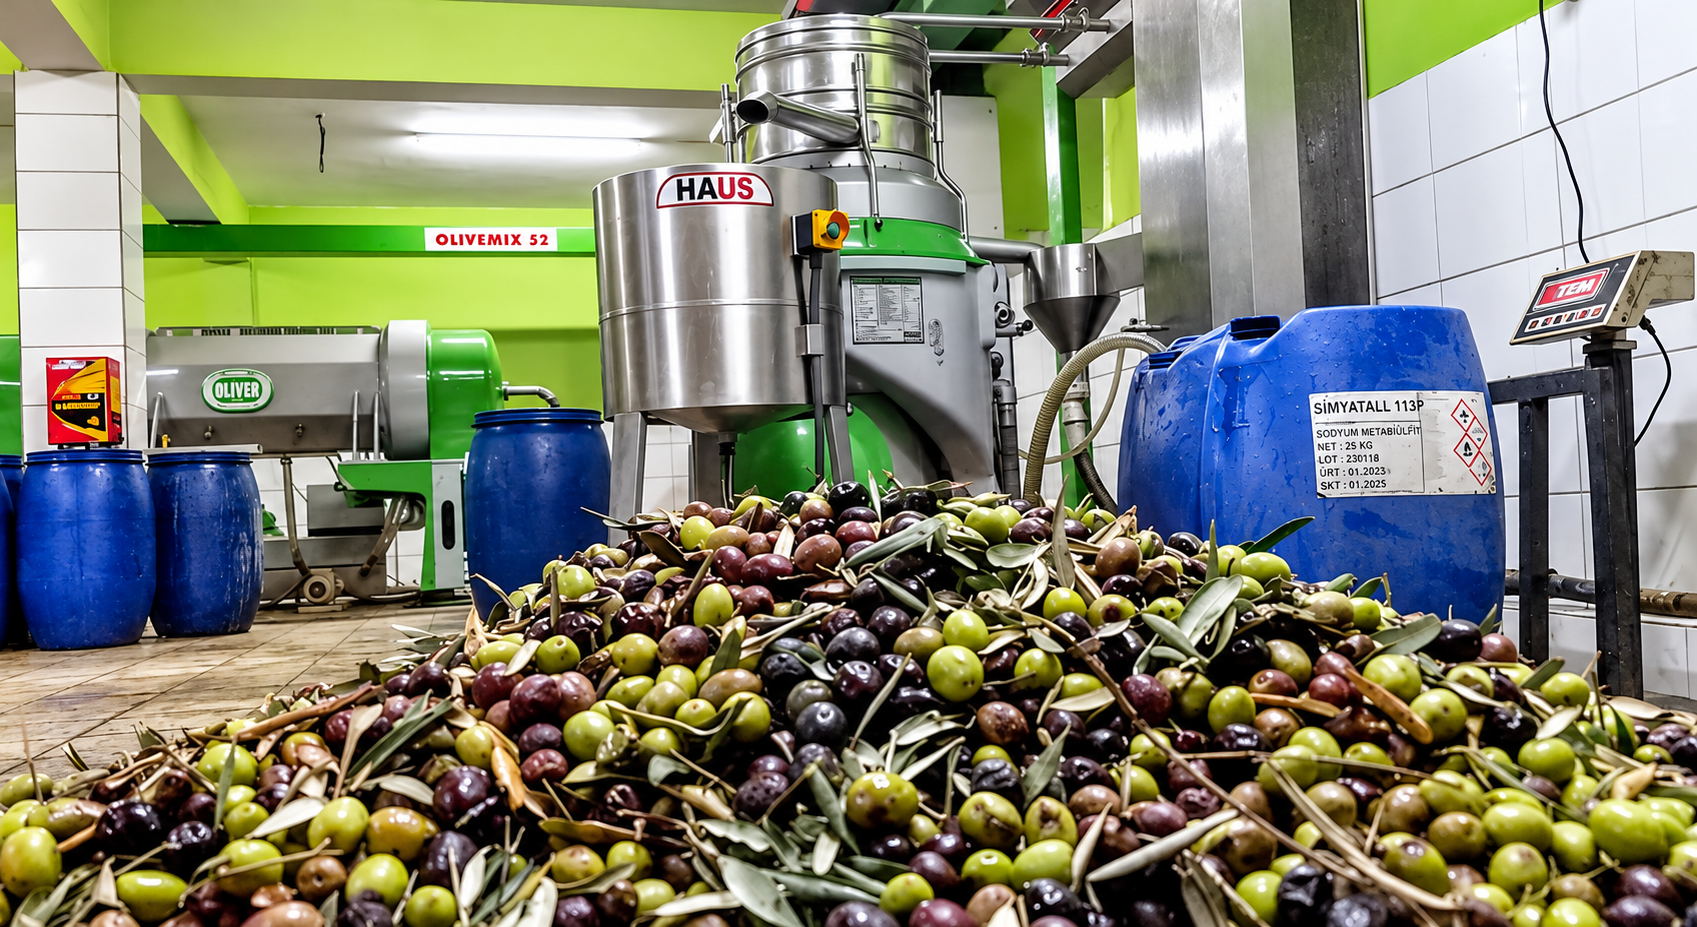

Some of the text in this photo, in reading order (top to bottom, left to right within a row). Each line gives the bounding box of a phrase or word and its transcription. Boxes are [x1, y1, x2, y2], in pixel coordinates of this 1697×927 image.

[676, 177, 754, 202] HAUS
[435, 233, 549, 246] OLIVEMIX 52
[1556, 278, 1596, 298] TEM
[214, 381, 260, 399] OLIVER
[1394, 400, 1424, 412] 113P
[1316, 428, 1359, 439] SODYUM
[1317, 442, 1337, 451] NET
[1359, 441, 1373, 449] KG
[1318, 455, 1338, 464] LOT
[1346, 453, 1380, 463] 230118
[1348, 466, 1386, 476] 01.2023
[1320, 481, 1341, 490] SKT
